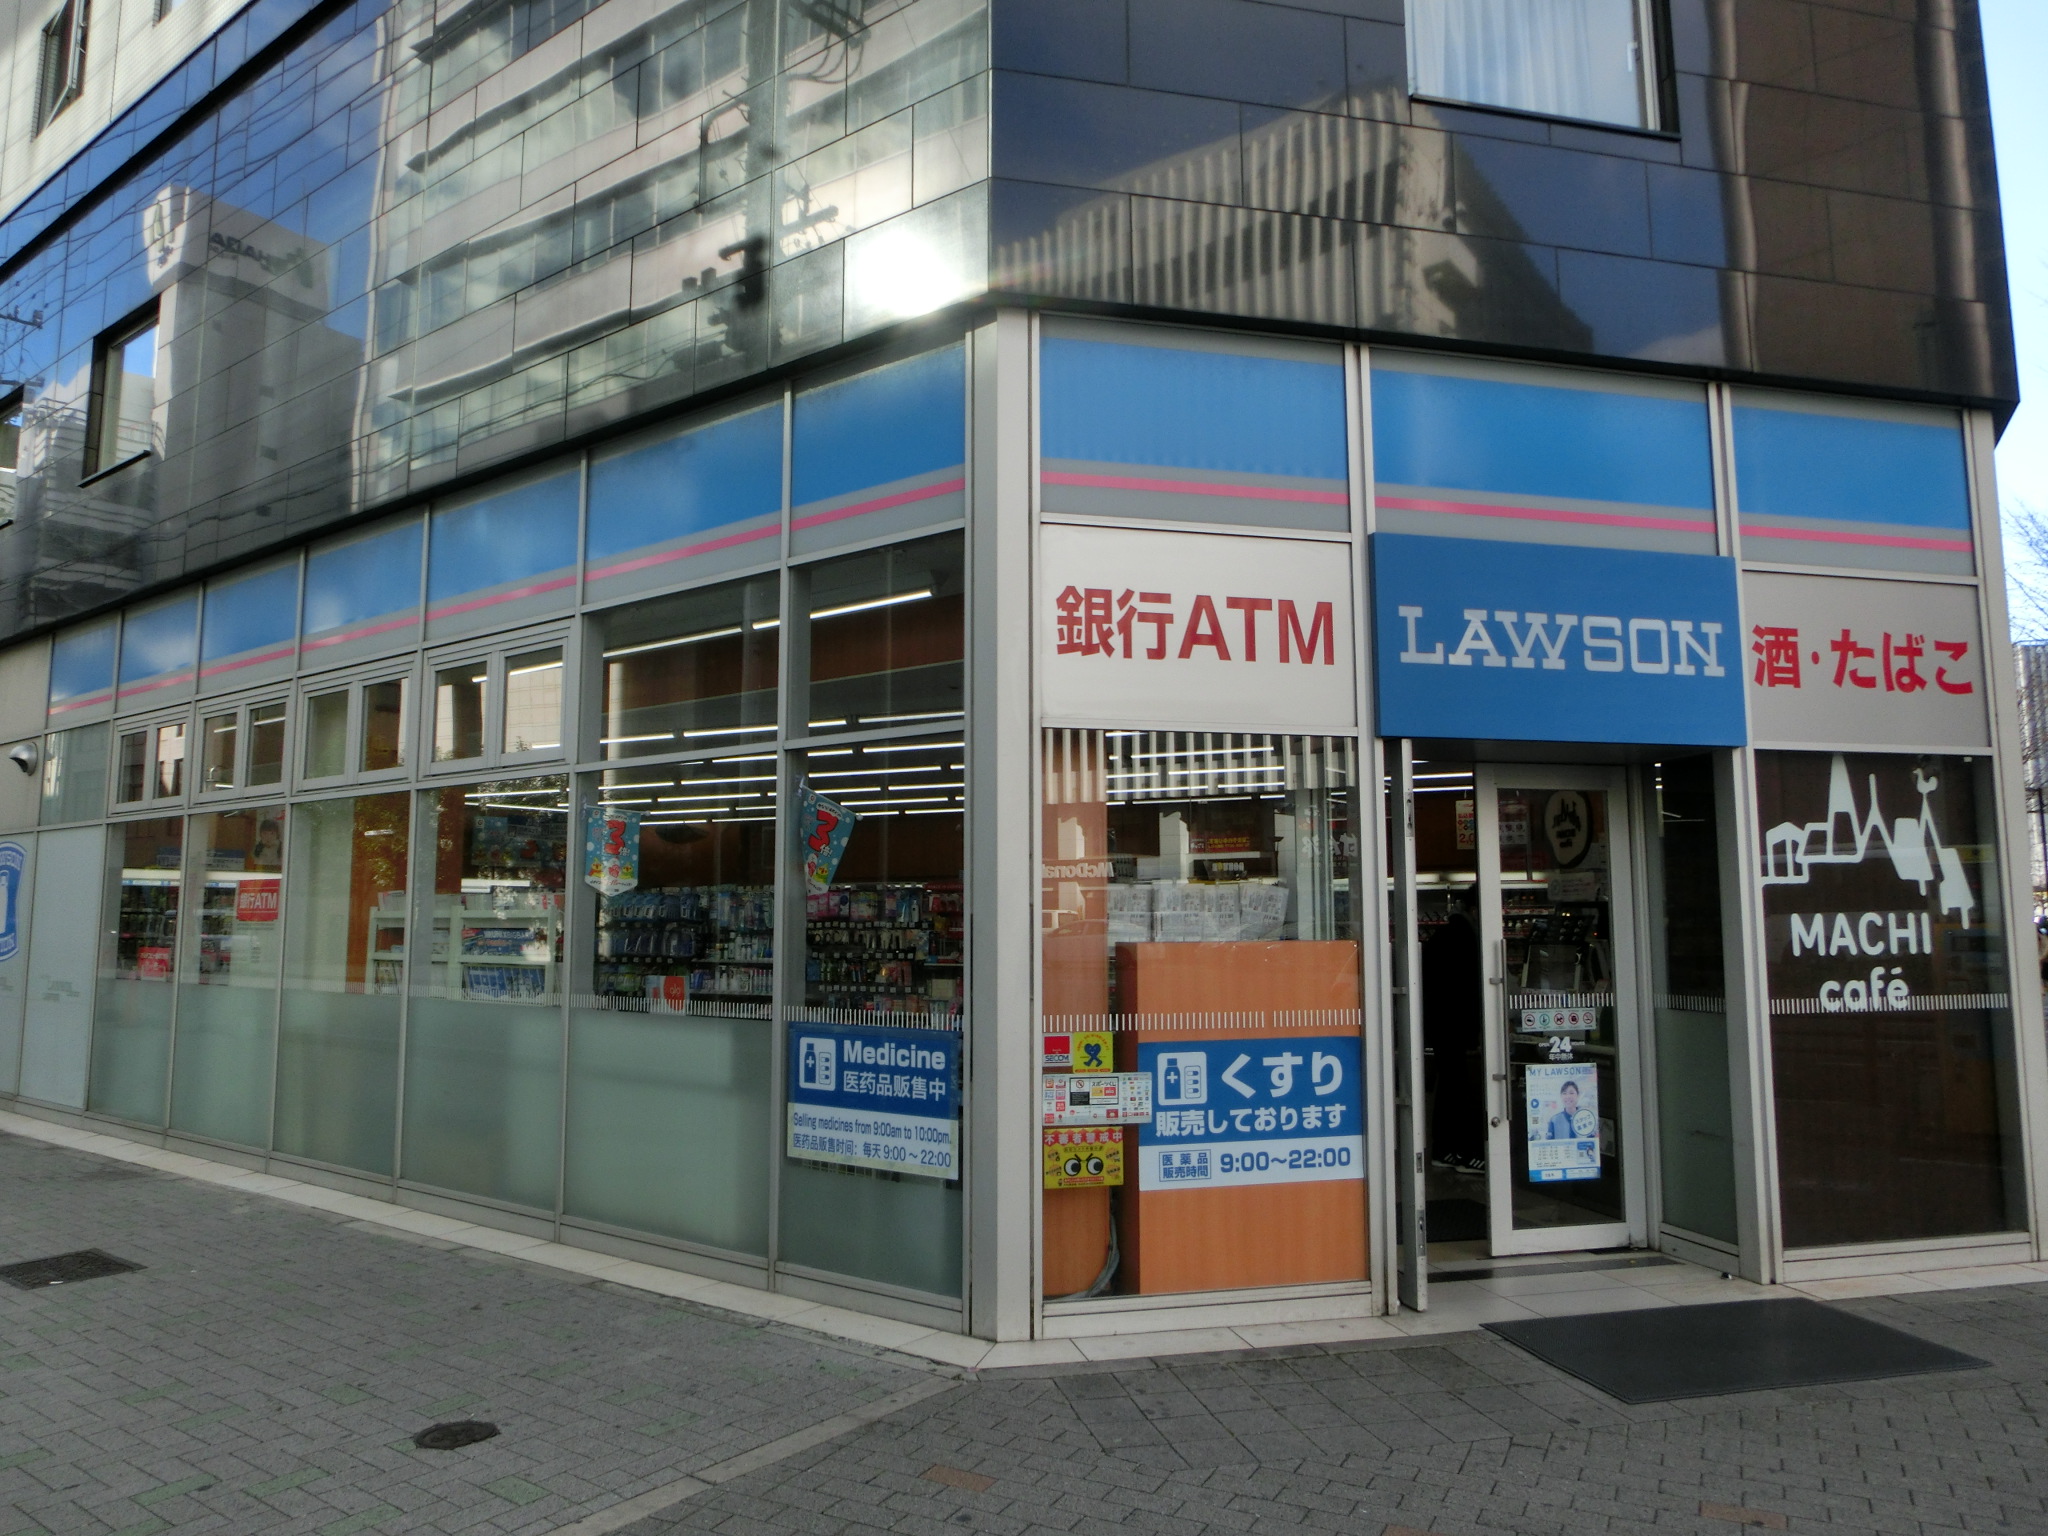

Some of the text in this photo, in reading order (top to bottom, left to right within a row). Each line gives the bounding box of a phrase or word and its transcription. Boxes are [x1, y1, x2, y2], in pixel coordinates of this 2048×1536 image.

[1056, 585, 1335, 665] 銀行ATM
[1398, 605, 1725, 677] LAWSON
[1752, 624, 1974, 694] 酒・たばこ
[239, 892, 278, 910] 銀行ATM
[1791, 912, 1932, 957] MACHI
[1819, 966, 1910, 1011] café
[843, 1039, 946, 1071] Medicine
[1045, 1054, 1069, 1062] SECOM
[1550, 1036, 1572, 1053] 24
[843, 1071, 946, 1102] 医药品贩售中
[1221, 1051, 1344, 1099] くすり
[1529, 1068, 1542, 1076] MY
[1544, 1066, 1582, 1076] LAWSON
[793, 1112, 952, 1144] Selling medicines from 9:00am to 10:00pm.
[1155, 1103, 1347, 1137] 販売しております
[1162, 1165, 1209, 1179] 販売時間
